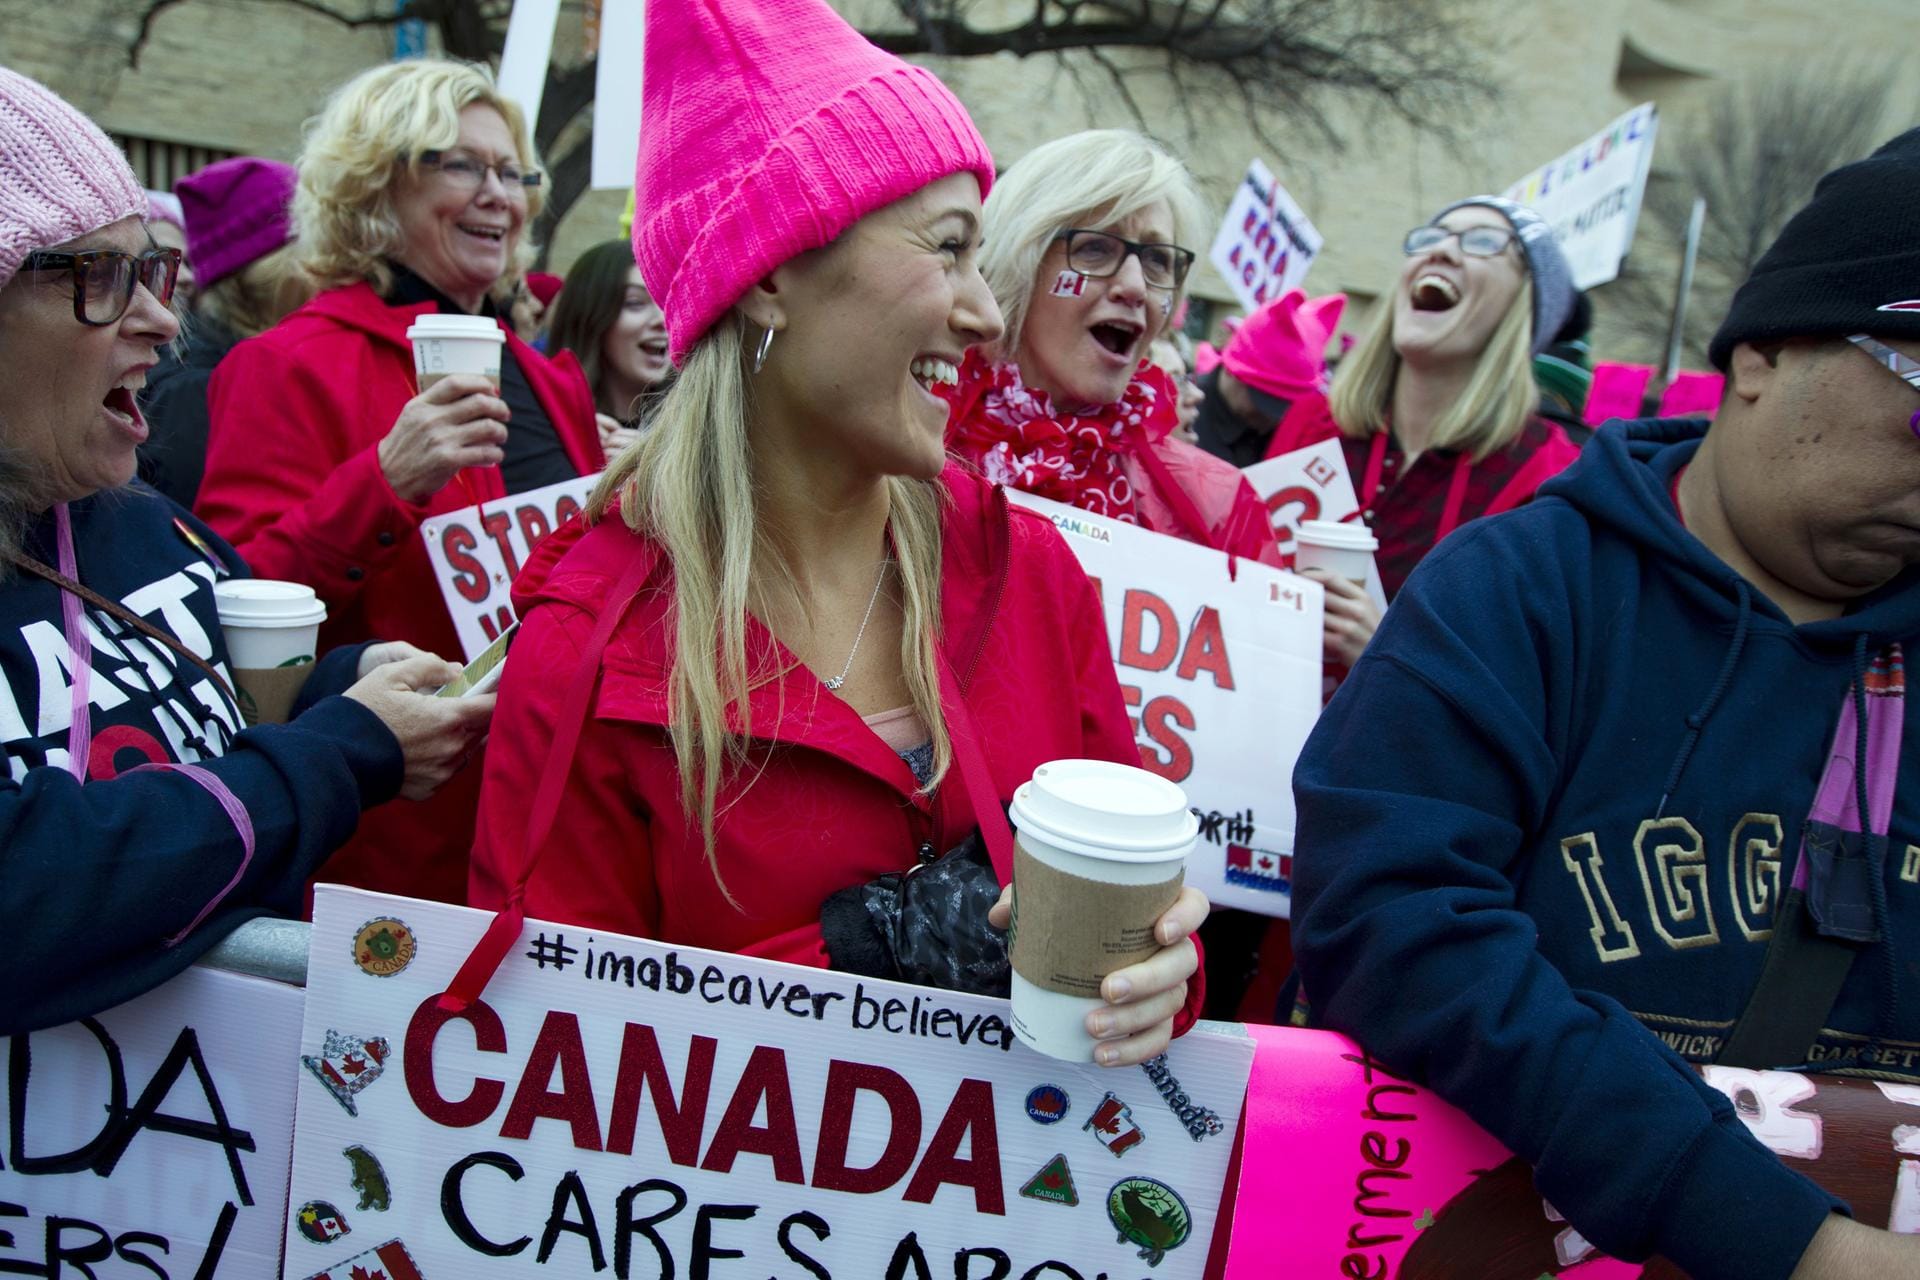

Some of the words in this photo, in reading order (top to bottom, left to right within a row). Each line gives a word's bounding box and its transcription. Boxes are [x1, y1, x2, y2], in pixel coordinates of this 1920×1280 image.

[442, 489, 593, 603] STR
[1050, 513, 1110, 543] CANADA
[0, 561, 217, 738] AST
[1090, 574, 1236, 692] DA
[1561, 812, 1920, 963] IGG
[372, 942, 413, 972] CANADA
[1653, 1030, 1719, 1057] WICK
[0, 1017, 257, 1207] DA
[403, 991, 1006, 1216] CANADA
[1029, 1107, 1060, 1120] CANADA
[440, 1150, 832, 1280] CARES
[1034, 1187, 1066, 1201] CANADA
